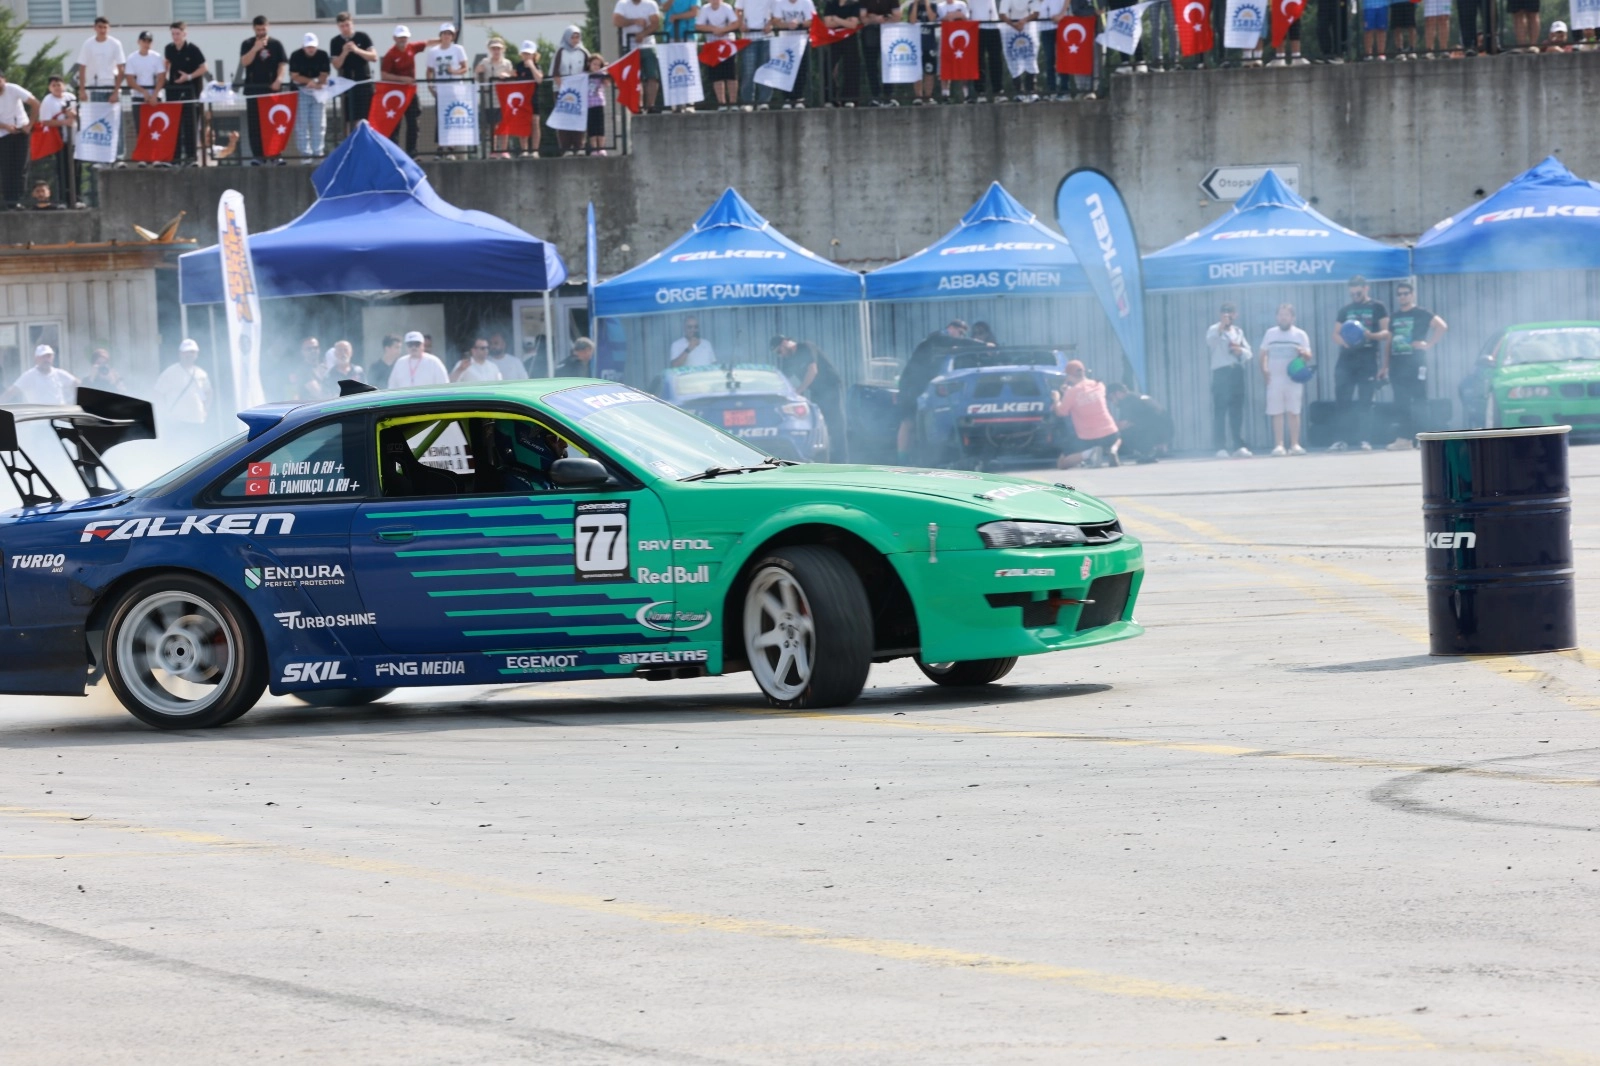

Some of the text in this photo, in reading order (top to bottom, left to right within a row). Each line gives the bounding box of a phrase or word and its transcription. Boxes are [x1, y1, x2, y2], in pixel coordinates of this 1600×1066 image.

[1473, 205, 1600, 225] FALKE
[1212, 228, 1329, 240] FALKEN
[670, 250, 786, 263] FALKEN
[940, 242, 1055, 255] FALKEN
[1085, 192, 1130, 319] FALKEN
[1209, 260, 1335, 279] DRIFTHERAPY
[938, 268, 1060, 290] ABBAS ÇİMEN
[655, 284, 800, 304] ÖRGE PAMUKÇU
[967, 401, 1044, 414] FALKEN
[270, 464, 279, 476] A.
[282, 460, 310, 478] ÇİMEN
[269, 479, 278, 494] Ö.
[280, 479, 323, 494] PAMUKÇU
[327, 480, 335, 492] A
[80, 512, 296, 543] FALKEN
[580, 525, 622, 561] 77
[638, 539, 713, 551] RAVENOL
[12, 553, 66, 569] TURBO
[264, 564, 345, 580] ENDURA
[994, 568, 1055, 577] FALKEN
[264, 580, 297, 588] PERFECT
[375, 660, 465, 677] FNG MEDIA
[506, 654, 579, 669] EGEMOT
[280, 660, 347, 684] SKIL
